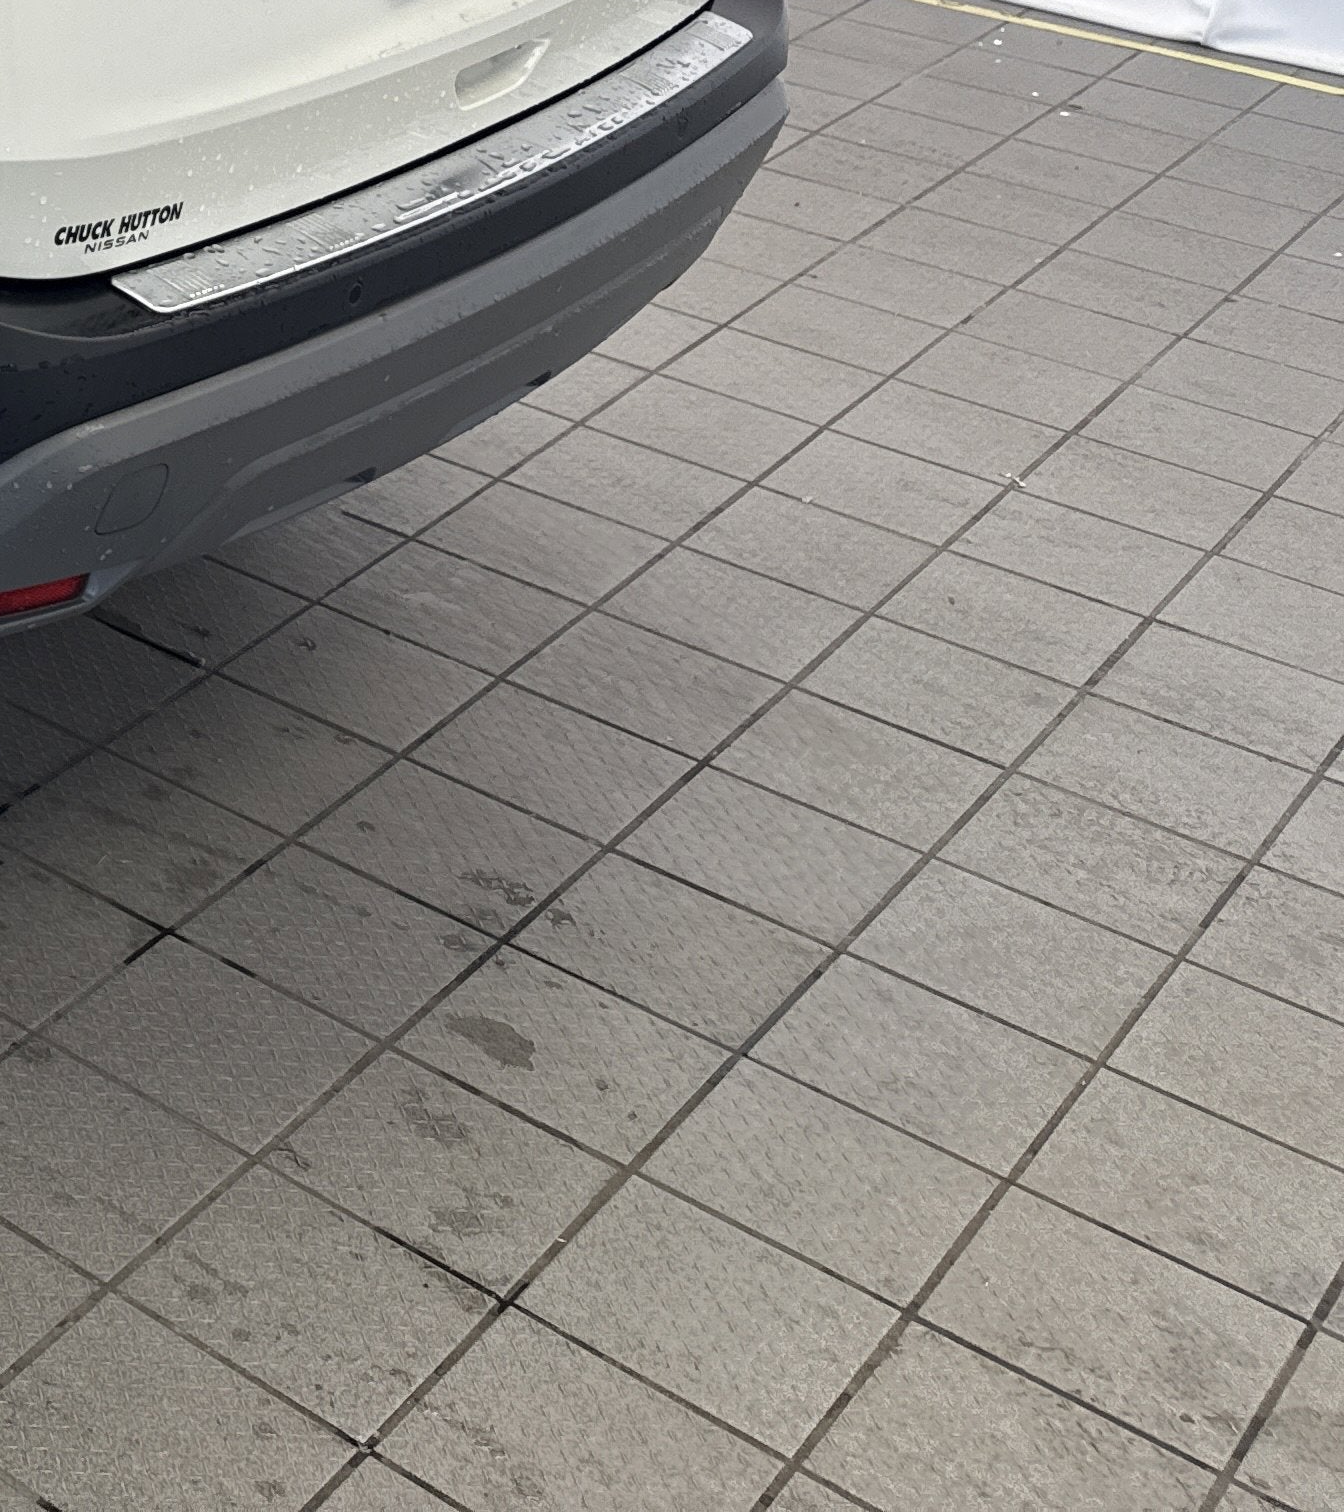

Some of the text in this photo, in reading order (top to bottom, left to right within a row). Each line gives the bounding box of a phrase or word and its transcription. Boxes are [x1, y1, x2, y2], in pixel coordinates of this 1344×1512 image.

[54, 201, 184, 246] CHUCK HUTTON
[84, 230, 149, 254] NISSAN
